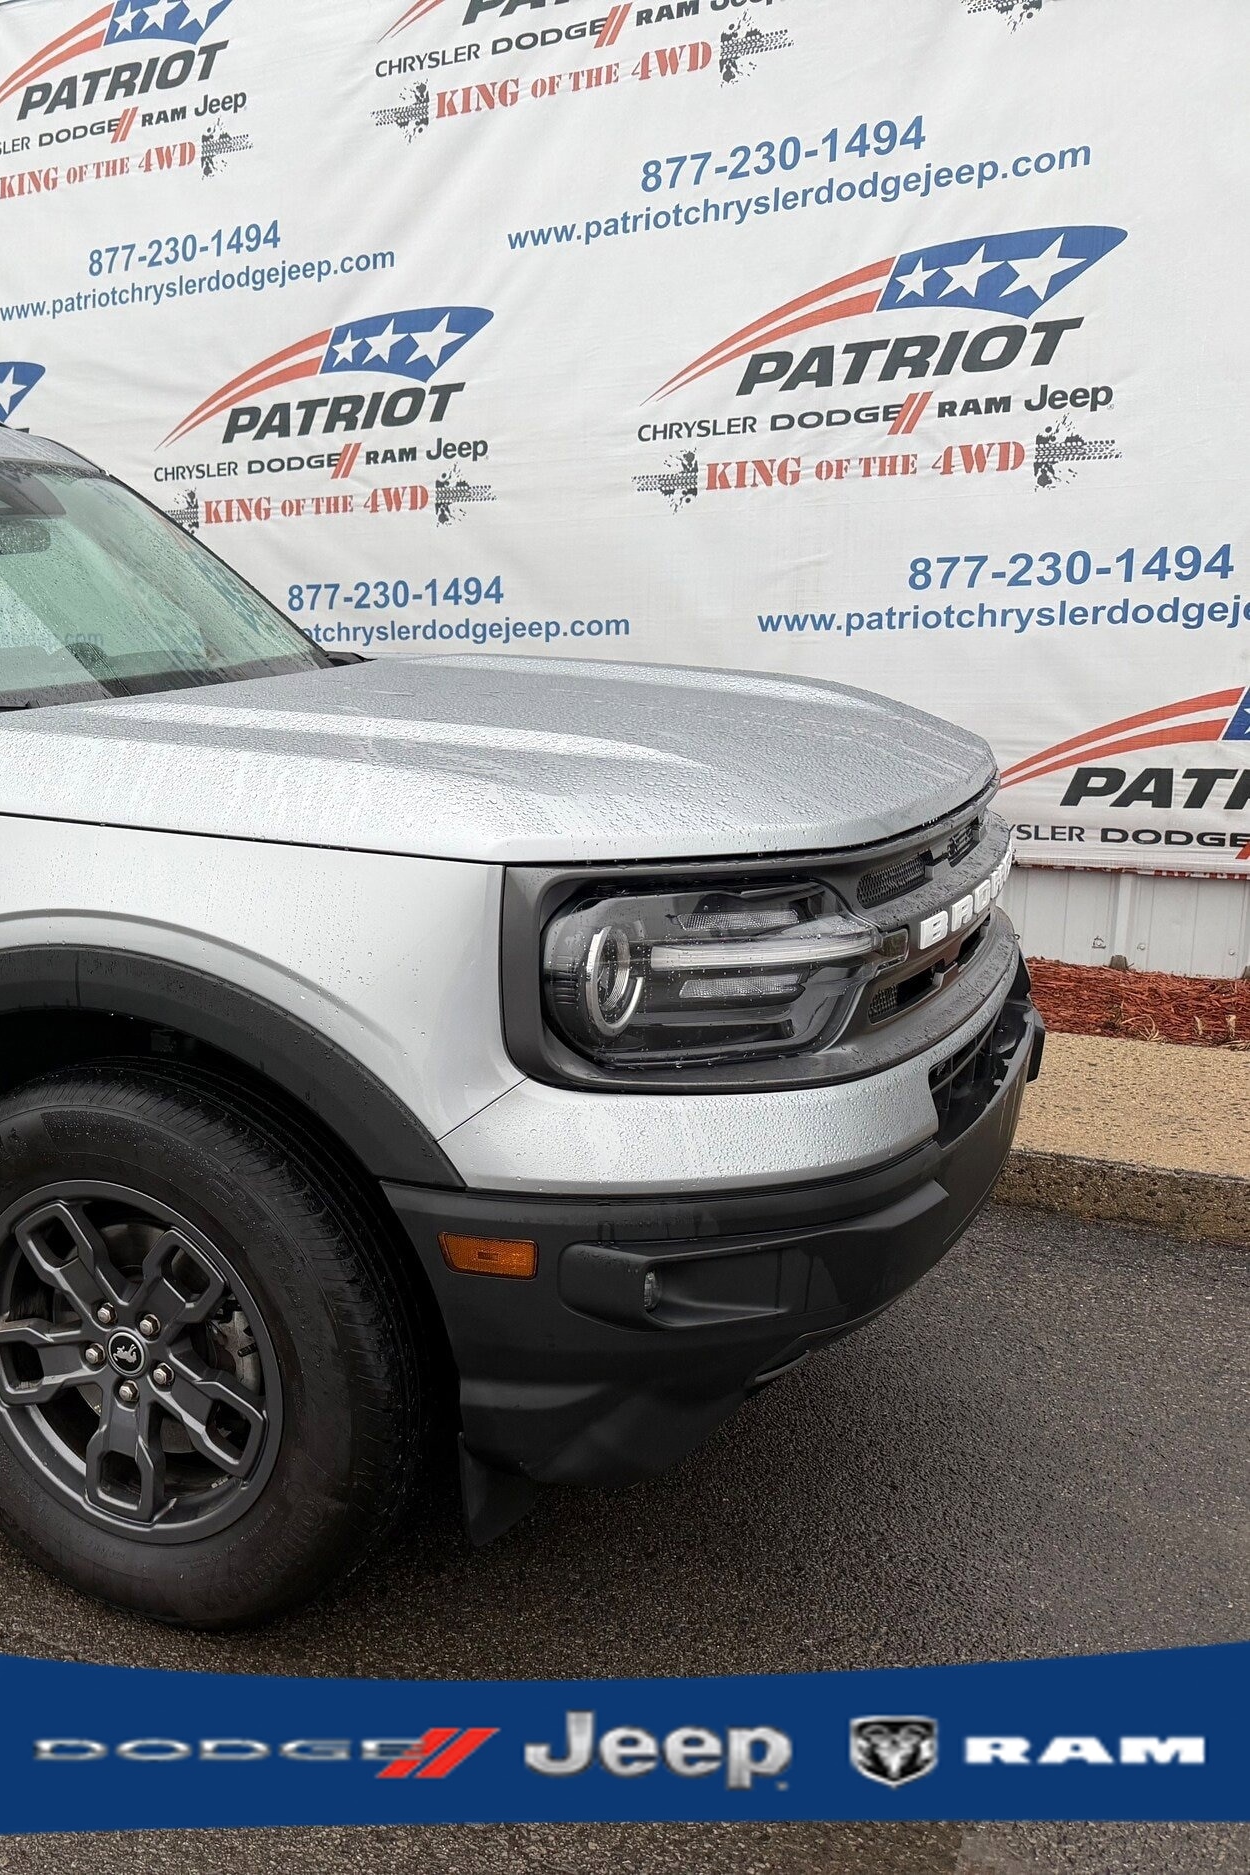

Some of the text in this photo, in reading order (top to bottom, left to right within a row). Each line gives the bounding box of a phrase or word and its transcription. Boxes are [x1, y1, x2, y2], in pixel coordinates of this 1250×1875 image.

[375, 0, 700, 78] CHRYSLER DODGE RAM
[17, 40, 230, 121] PATRIOT
[435, 41, 712, 119] KING OF THE 4WD
[38, 118, 121, 147] DODGE
[141, 106, 187, 127] RAM
[194, 91, 247, 117] Jeep
[0, 141, 196, 200] KING OF THE 4WD
[641, 115, 927, 194] 877-230-1494
[507, 140, 1092, 251] www.patriotchryslerdodgejeep.com
[88, 220, 281, 277] 877-230-1494
[0, 250, 395, 322] www.patriotchryslerdodgejeep.com
[736, 317, 1084, 397] PATRIOT
[222, 382, 466, 444] PATRIOT
[637, 384, 1114, 443] CHRYSLER DODGE RAM Jeep
[154, 438, 488, 482] CHRYSLER DODGE RAM Jeep
[705, 441, 1026, 492] KING OF THE 4WD
[204, 485, 429, 525] KING OF THE 4WD
[287, 575, 504, 612] 877-230-1494
[908, 544, 1235, 591] 877-230-1494
[1010, 824, 1086, 843] SLER
